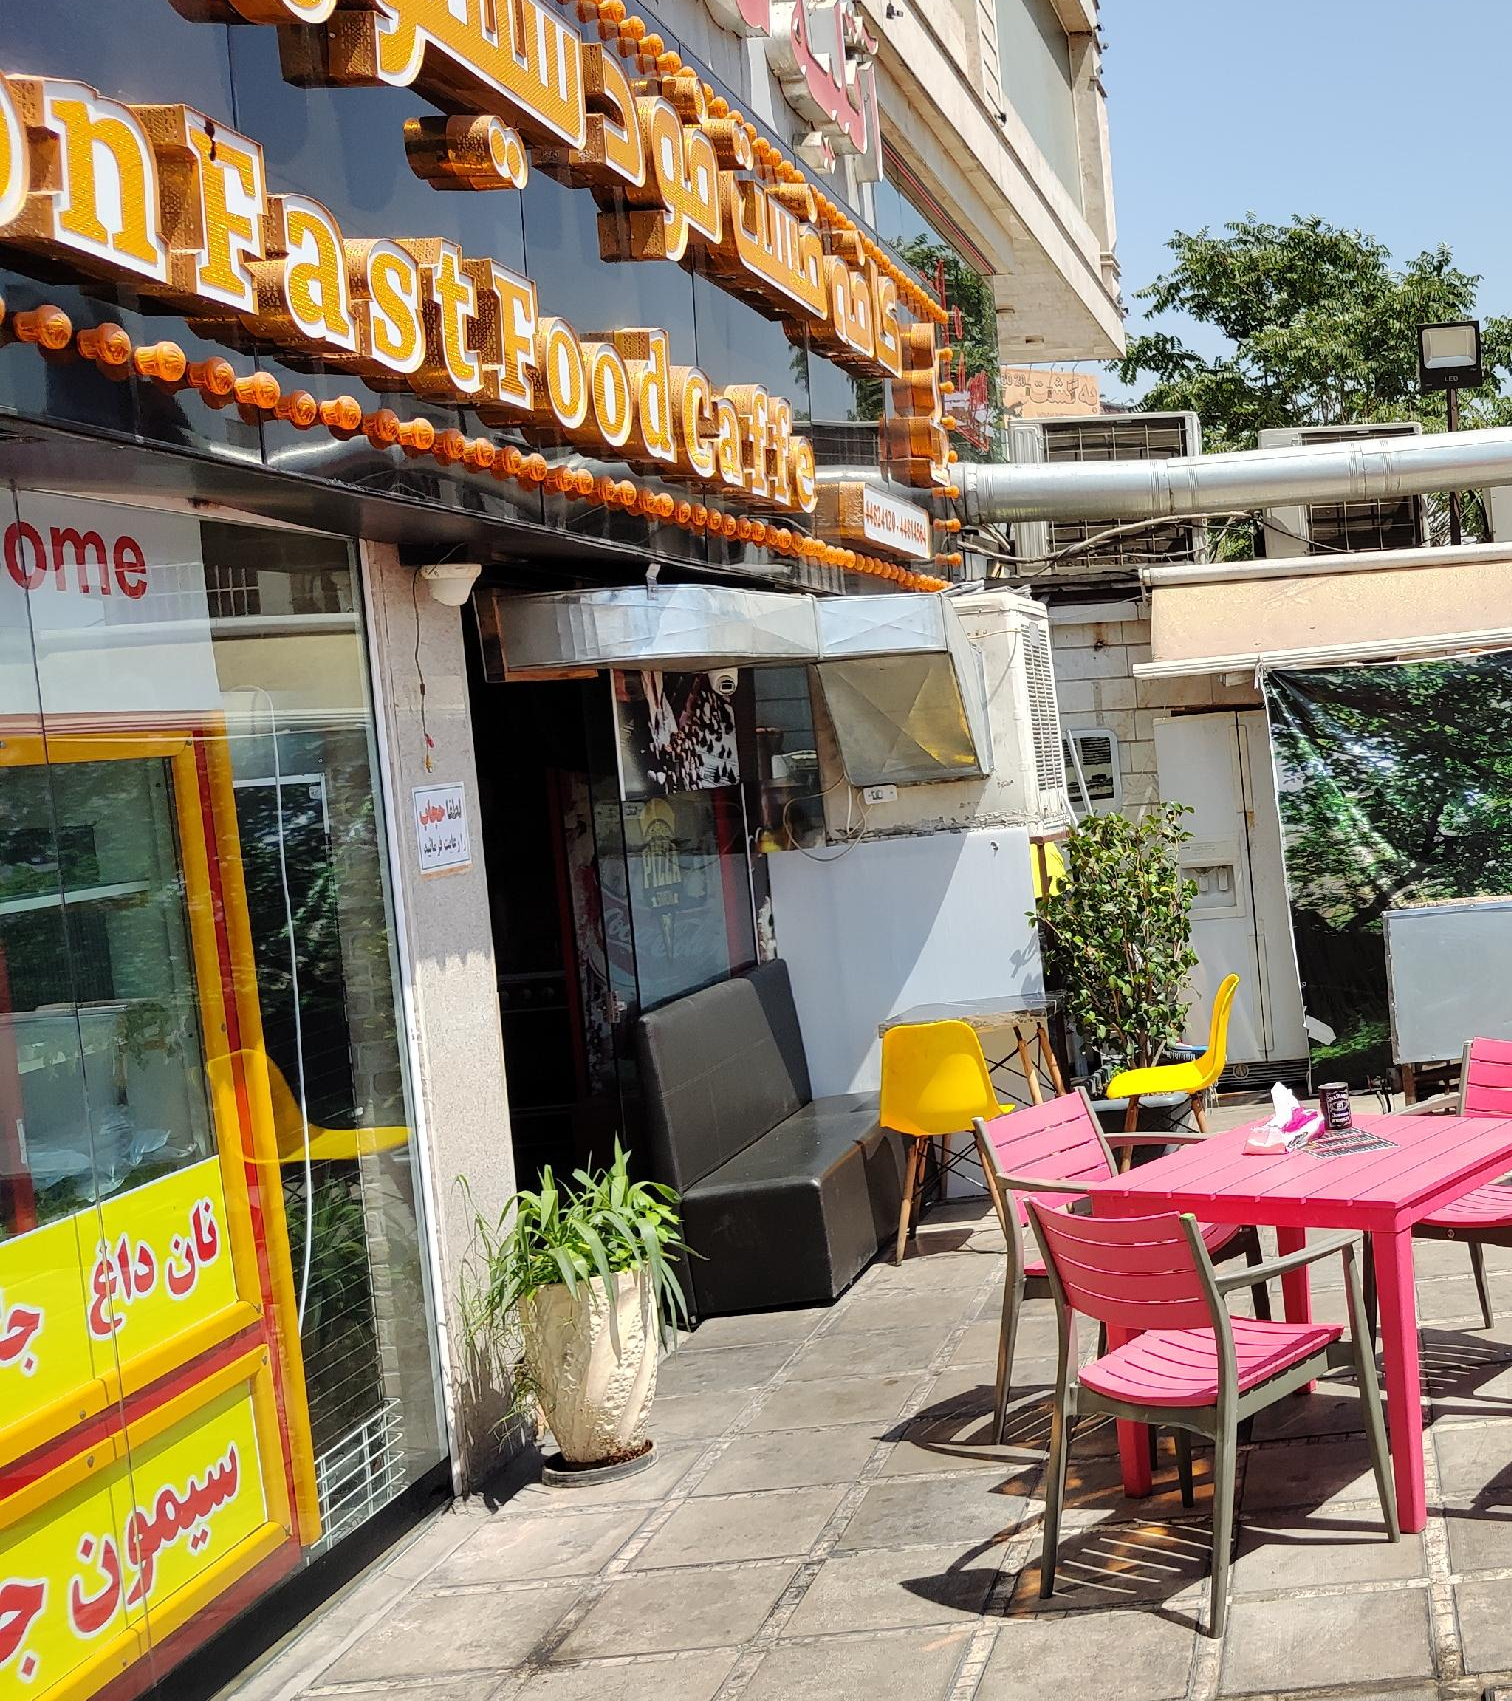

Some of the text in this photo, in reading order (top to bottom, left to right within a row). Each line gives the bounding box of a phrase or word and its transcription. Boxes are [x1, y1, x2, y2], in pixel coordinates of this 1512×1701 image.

[601, 50, 723, 261] فود
[184, 104, 482, 394] Fast
[490, 257, 677, 464] Food
[89, 1200, 219, 1338] نان داغ
[70, 1443, 239, 1637] سیمون
